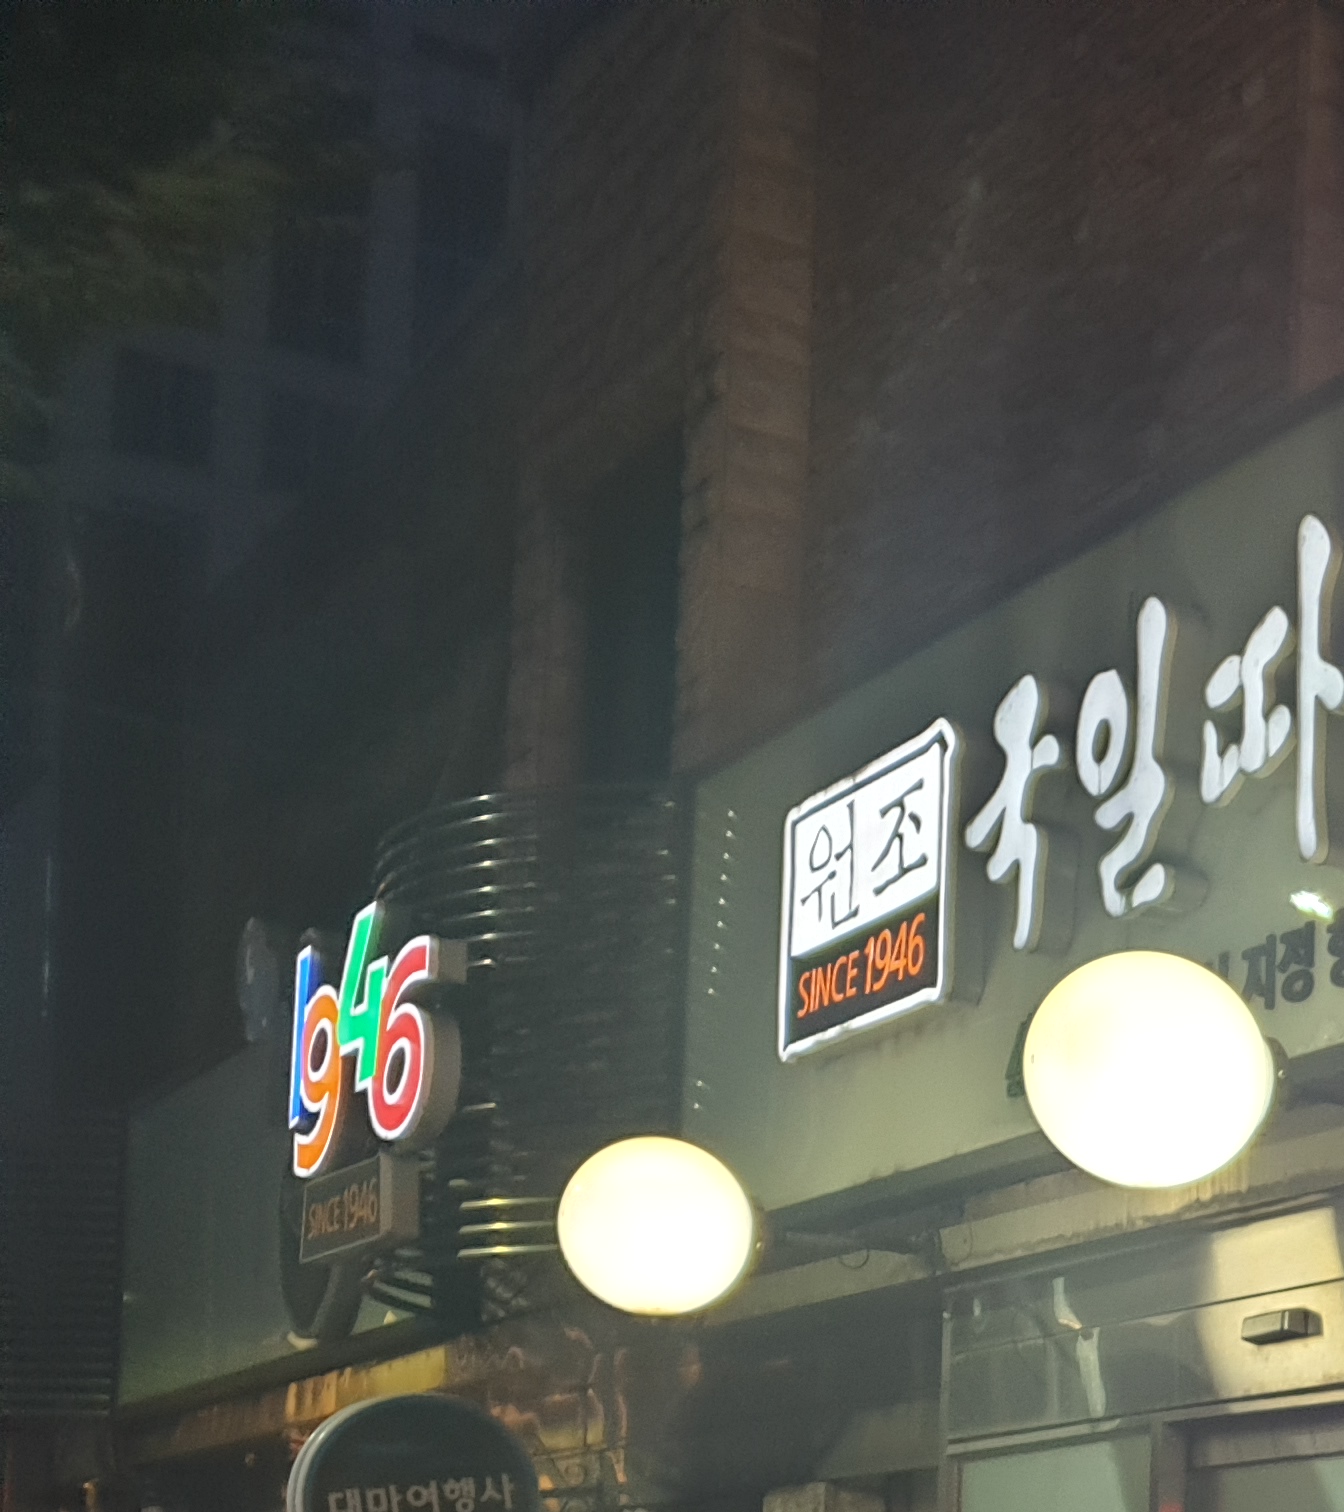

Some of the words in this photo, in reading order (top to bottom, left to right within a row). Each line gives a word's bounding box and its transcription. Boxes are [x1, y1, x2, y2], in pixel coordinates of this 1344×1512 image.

[801, 799, 929, 930] 원조
[797, 951, 860, 1019] SINCE
[864, 912, 926, 996] 1946
[1243, 921, 1316, 1010] 지정
[289, 900, 439, 1177] 1946
[308, 1195, 341, 1240] SINCE
[343, 1178, 378, 1232] 1946
